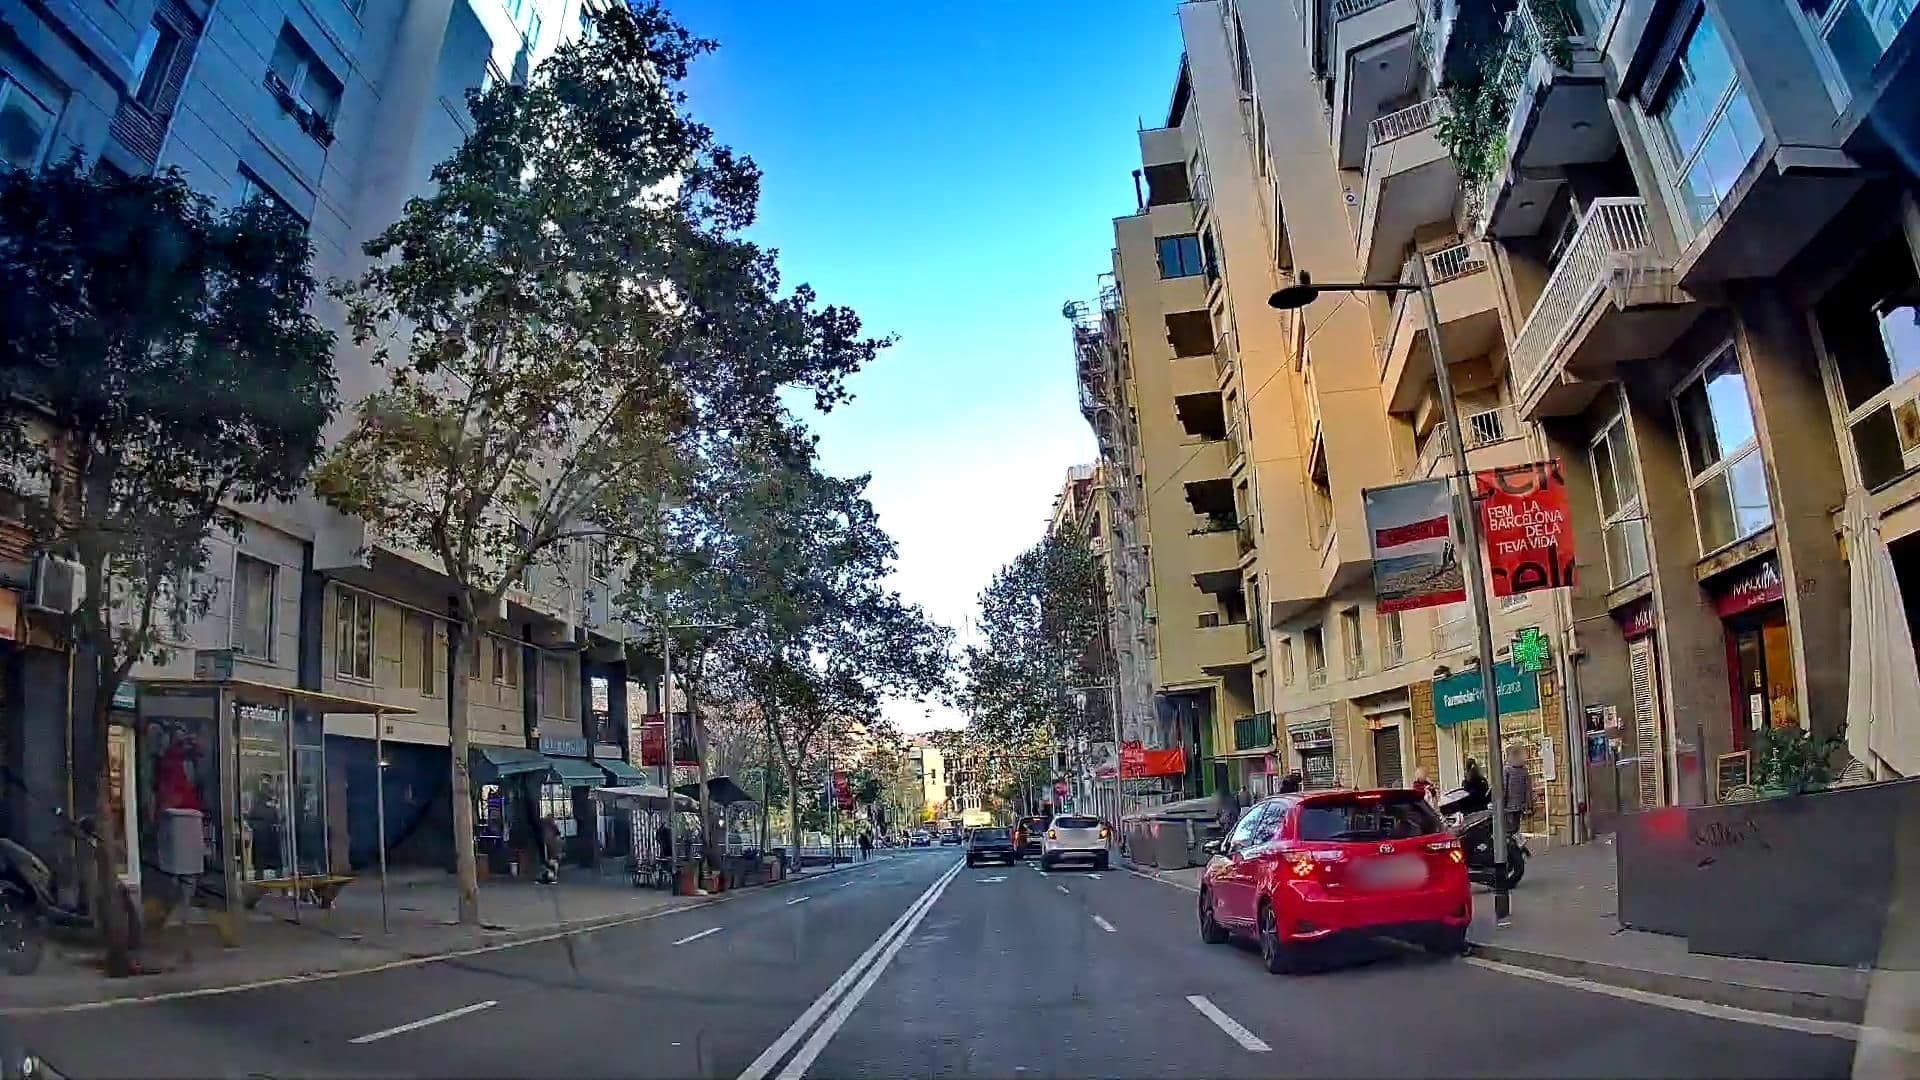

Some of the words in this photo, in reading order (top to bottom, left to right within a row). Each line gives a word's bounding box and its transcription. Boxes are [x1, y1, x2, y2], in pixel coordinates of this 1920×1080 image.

[1487, 504, 1513, 519] FEM
[1522, 500, 1540, 513] LA
[1490, 509, 1563, 531] BARCELONA
[1525, 525, 1543, 539] DE
[1544, 522, 1562, 536] LA
[1496, 539, 1528, 554] TEVA
[1529, 535, 1559, 549] VIDA
